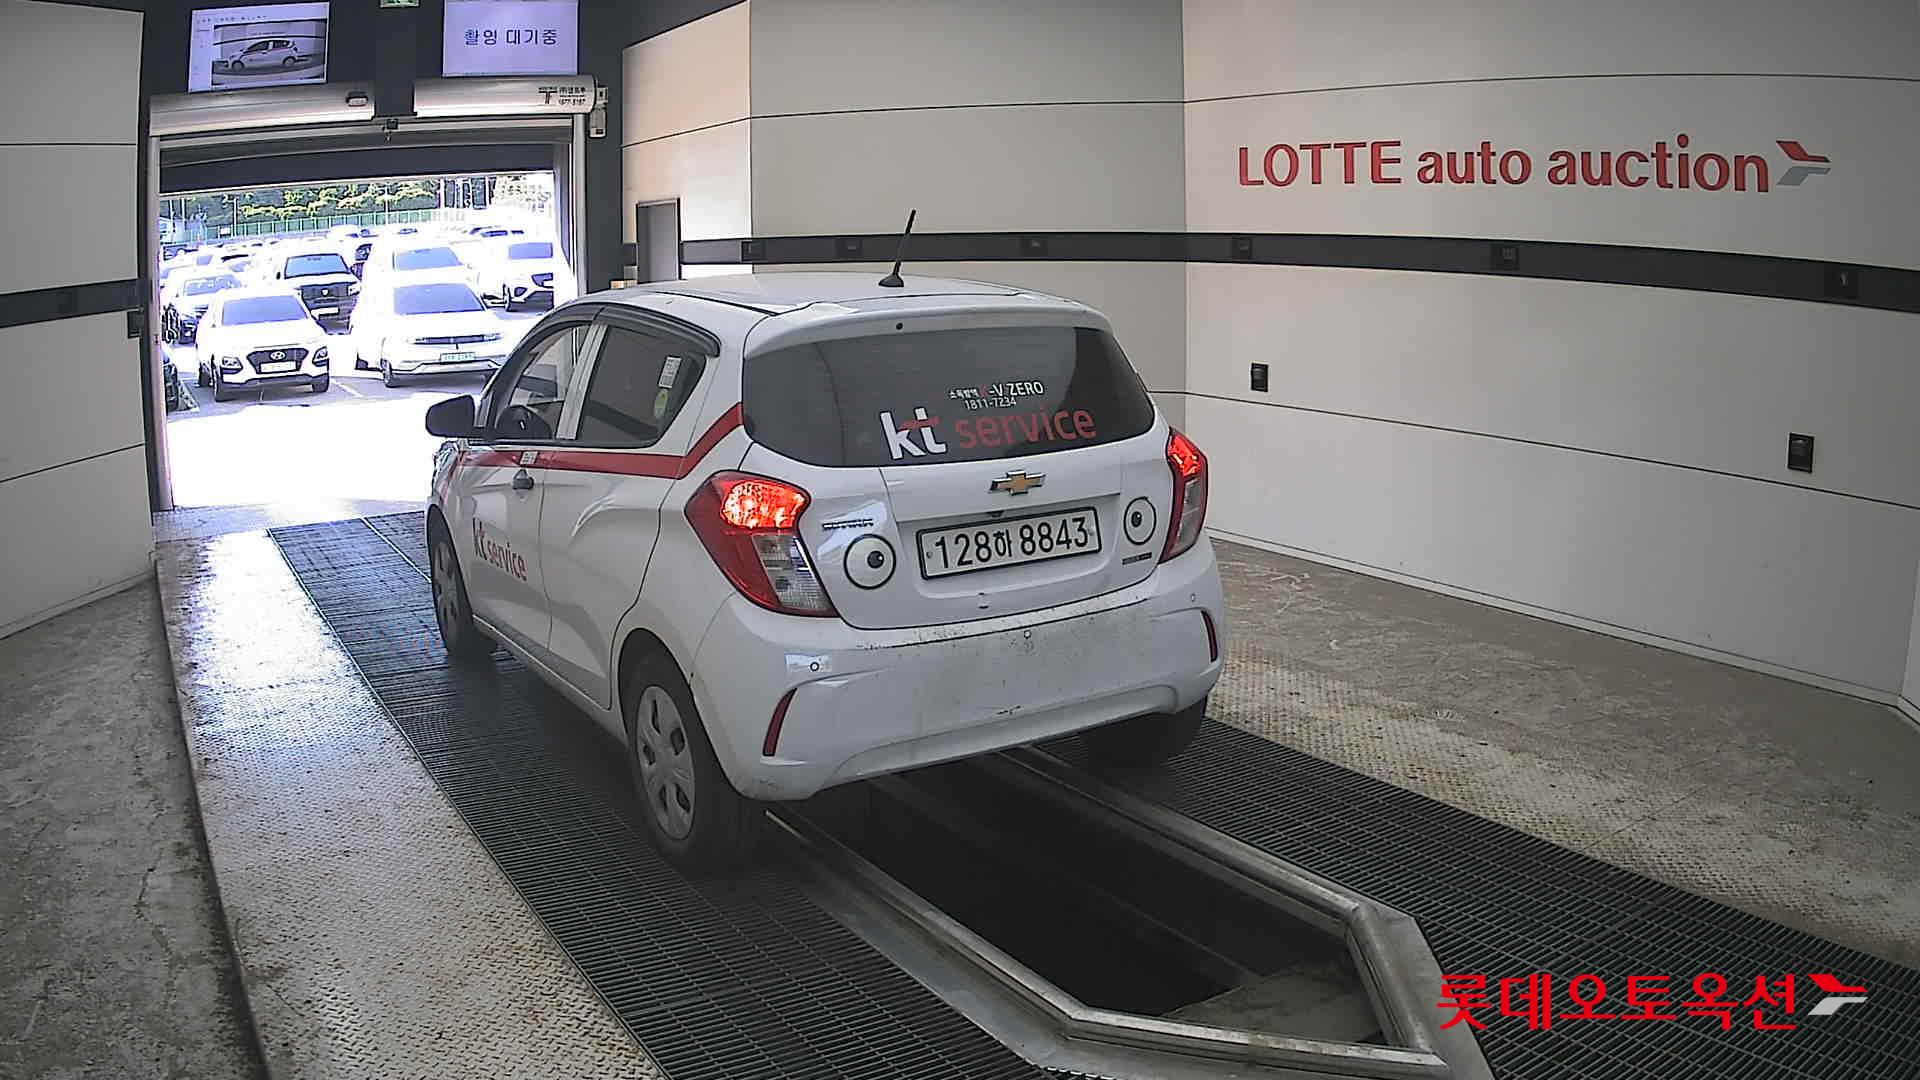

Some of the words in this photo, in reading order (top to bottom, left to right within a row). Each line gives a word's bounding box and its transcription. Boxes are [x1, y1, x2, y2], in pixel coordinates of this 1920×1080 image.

[505, 28, 558, 46] 대기중
[1238, 141, 1402, 187] LOTTE
[1416, 140, 1533, 186] auto
[1546, 133, 1770, 193] auction
[963, 396, 1017, 411] 1811-7234
[1006, 382, 1044, 397] ZERO
[879, 407, 947, 460] kt
[955, 407, 1098, 450] service
[472, 517, 487, 561] kt
[487, 540, 528, 581] service
[935, 530, 1013, 569] 128하
[1020, 516, 1090, 557] 8843
